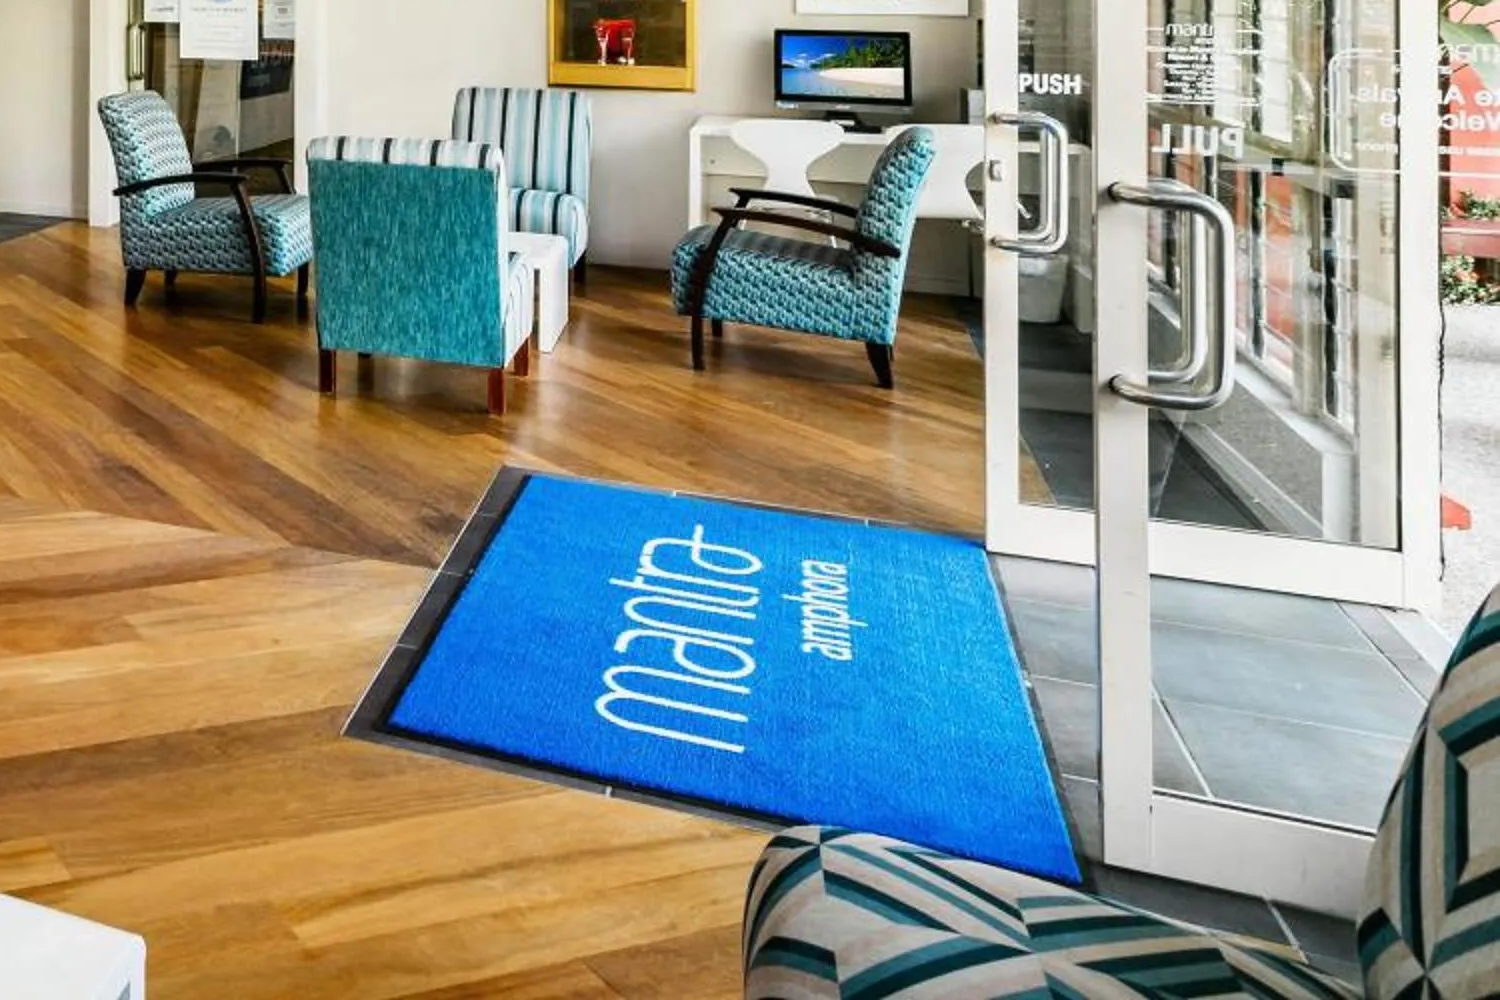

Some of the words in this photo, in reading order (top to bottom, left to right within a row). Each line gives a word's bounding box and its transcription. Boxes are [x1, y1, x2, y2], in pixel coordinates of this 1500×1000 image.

[1018, 73, 1082, 95] PUSH
[595, 523, 764, 754] mantra
[781, 559, 869, 661] amphora
